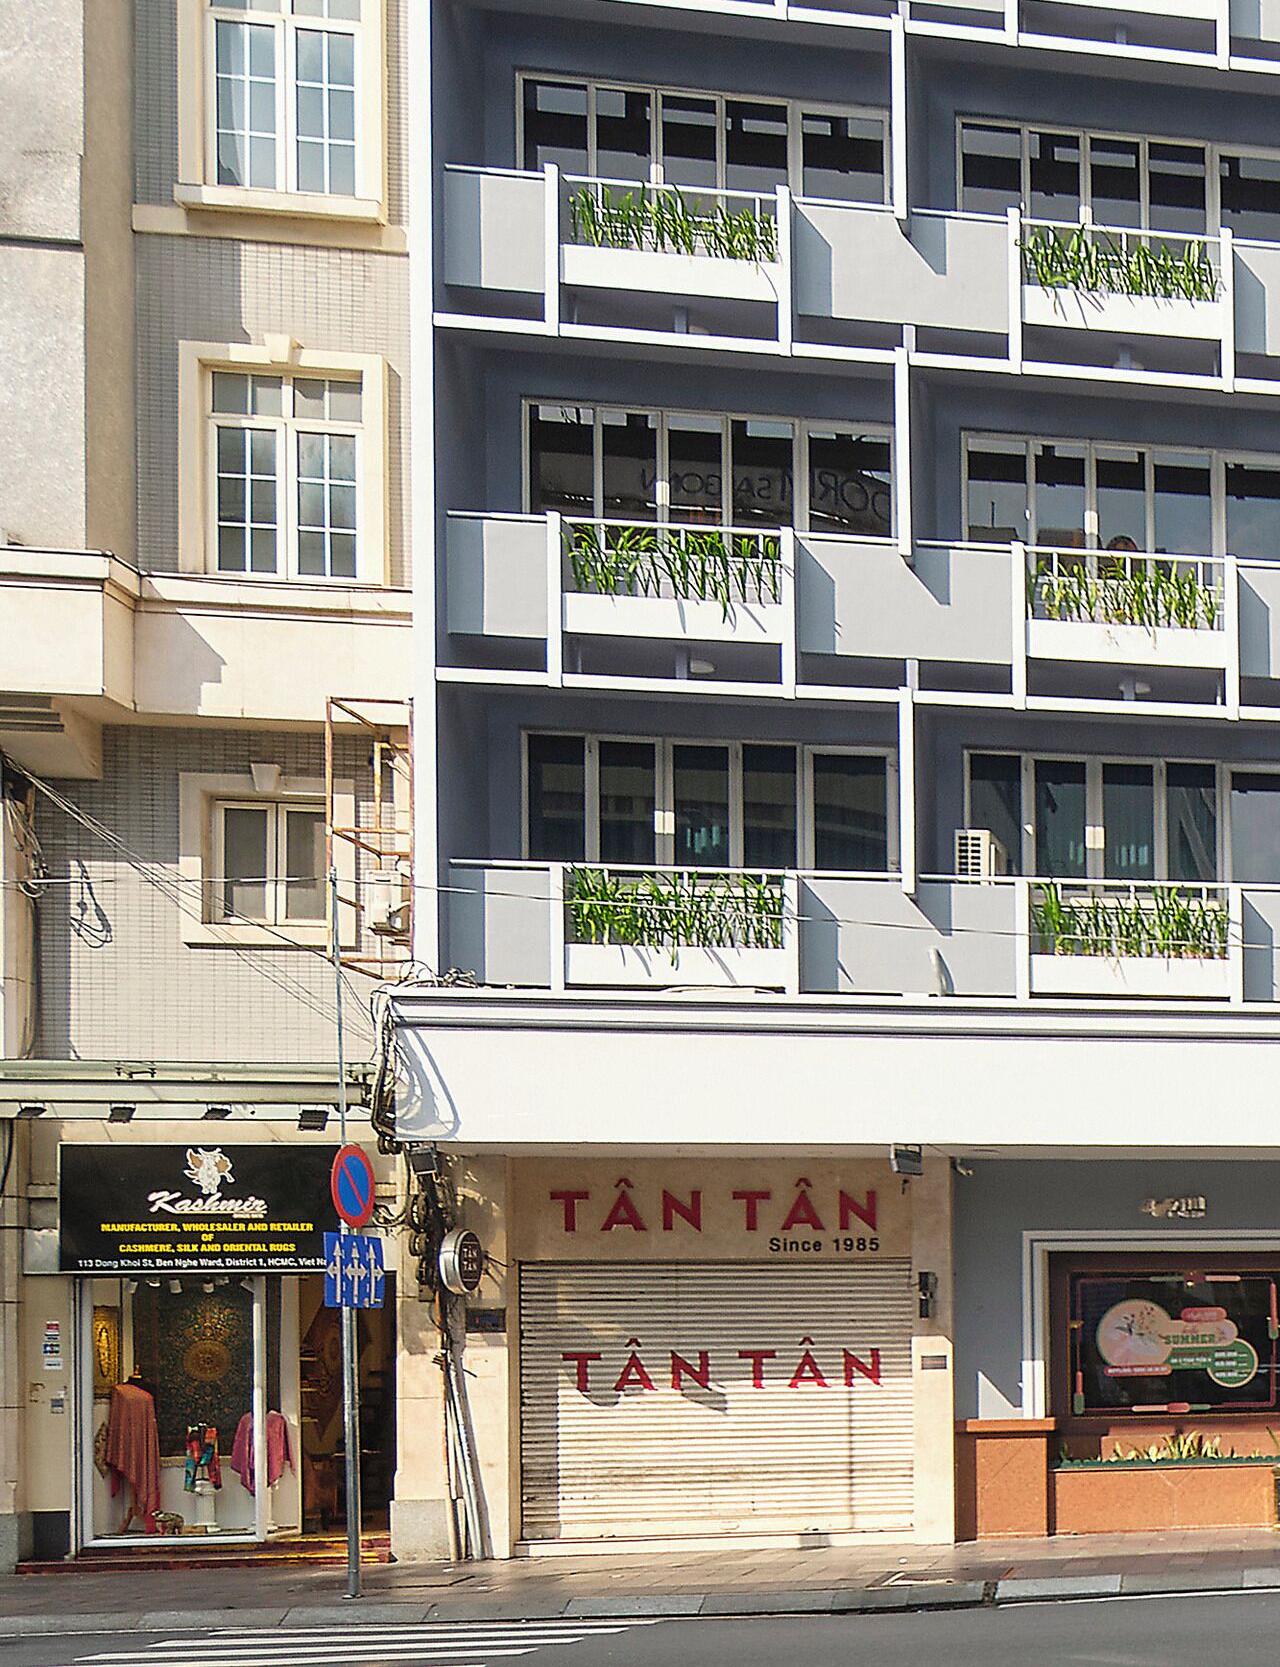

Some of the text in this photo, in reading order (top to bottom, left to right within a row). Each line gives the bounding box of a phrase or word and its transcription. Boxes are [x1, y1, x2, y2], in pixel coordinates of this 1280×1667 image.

[147, 1190, 268, 1213] Kashmir
[550, 1177, 878, 1232] TÂN TÂN
[100, 1223, 314, 1232] MANUFACTURER, WHOLESALER AND RETAILER
[201, 1233, 215, 1242] OF
[176, 1244, 199, 1252] SILK
[200, 1244, 221, 1252] AND
[222, 1243, 268, 1252] ORIENTAL
[269, 1243, 296, 1252] RUGS
[768, 1236, 880, 1253] Since 1985
[78, 1259, 94, 1267] 113
[155, 1259, 174, 1267] Ben
[225, 1257, 257, 1267] District
[562, 1336, 883, 1392] TÂN TÂN
